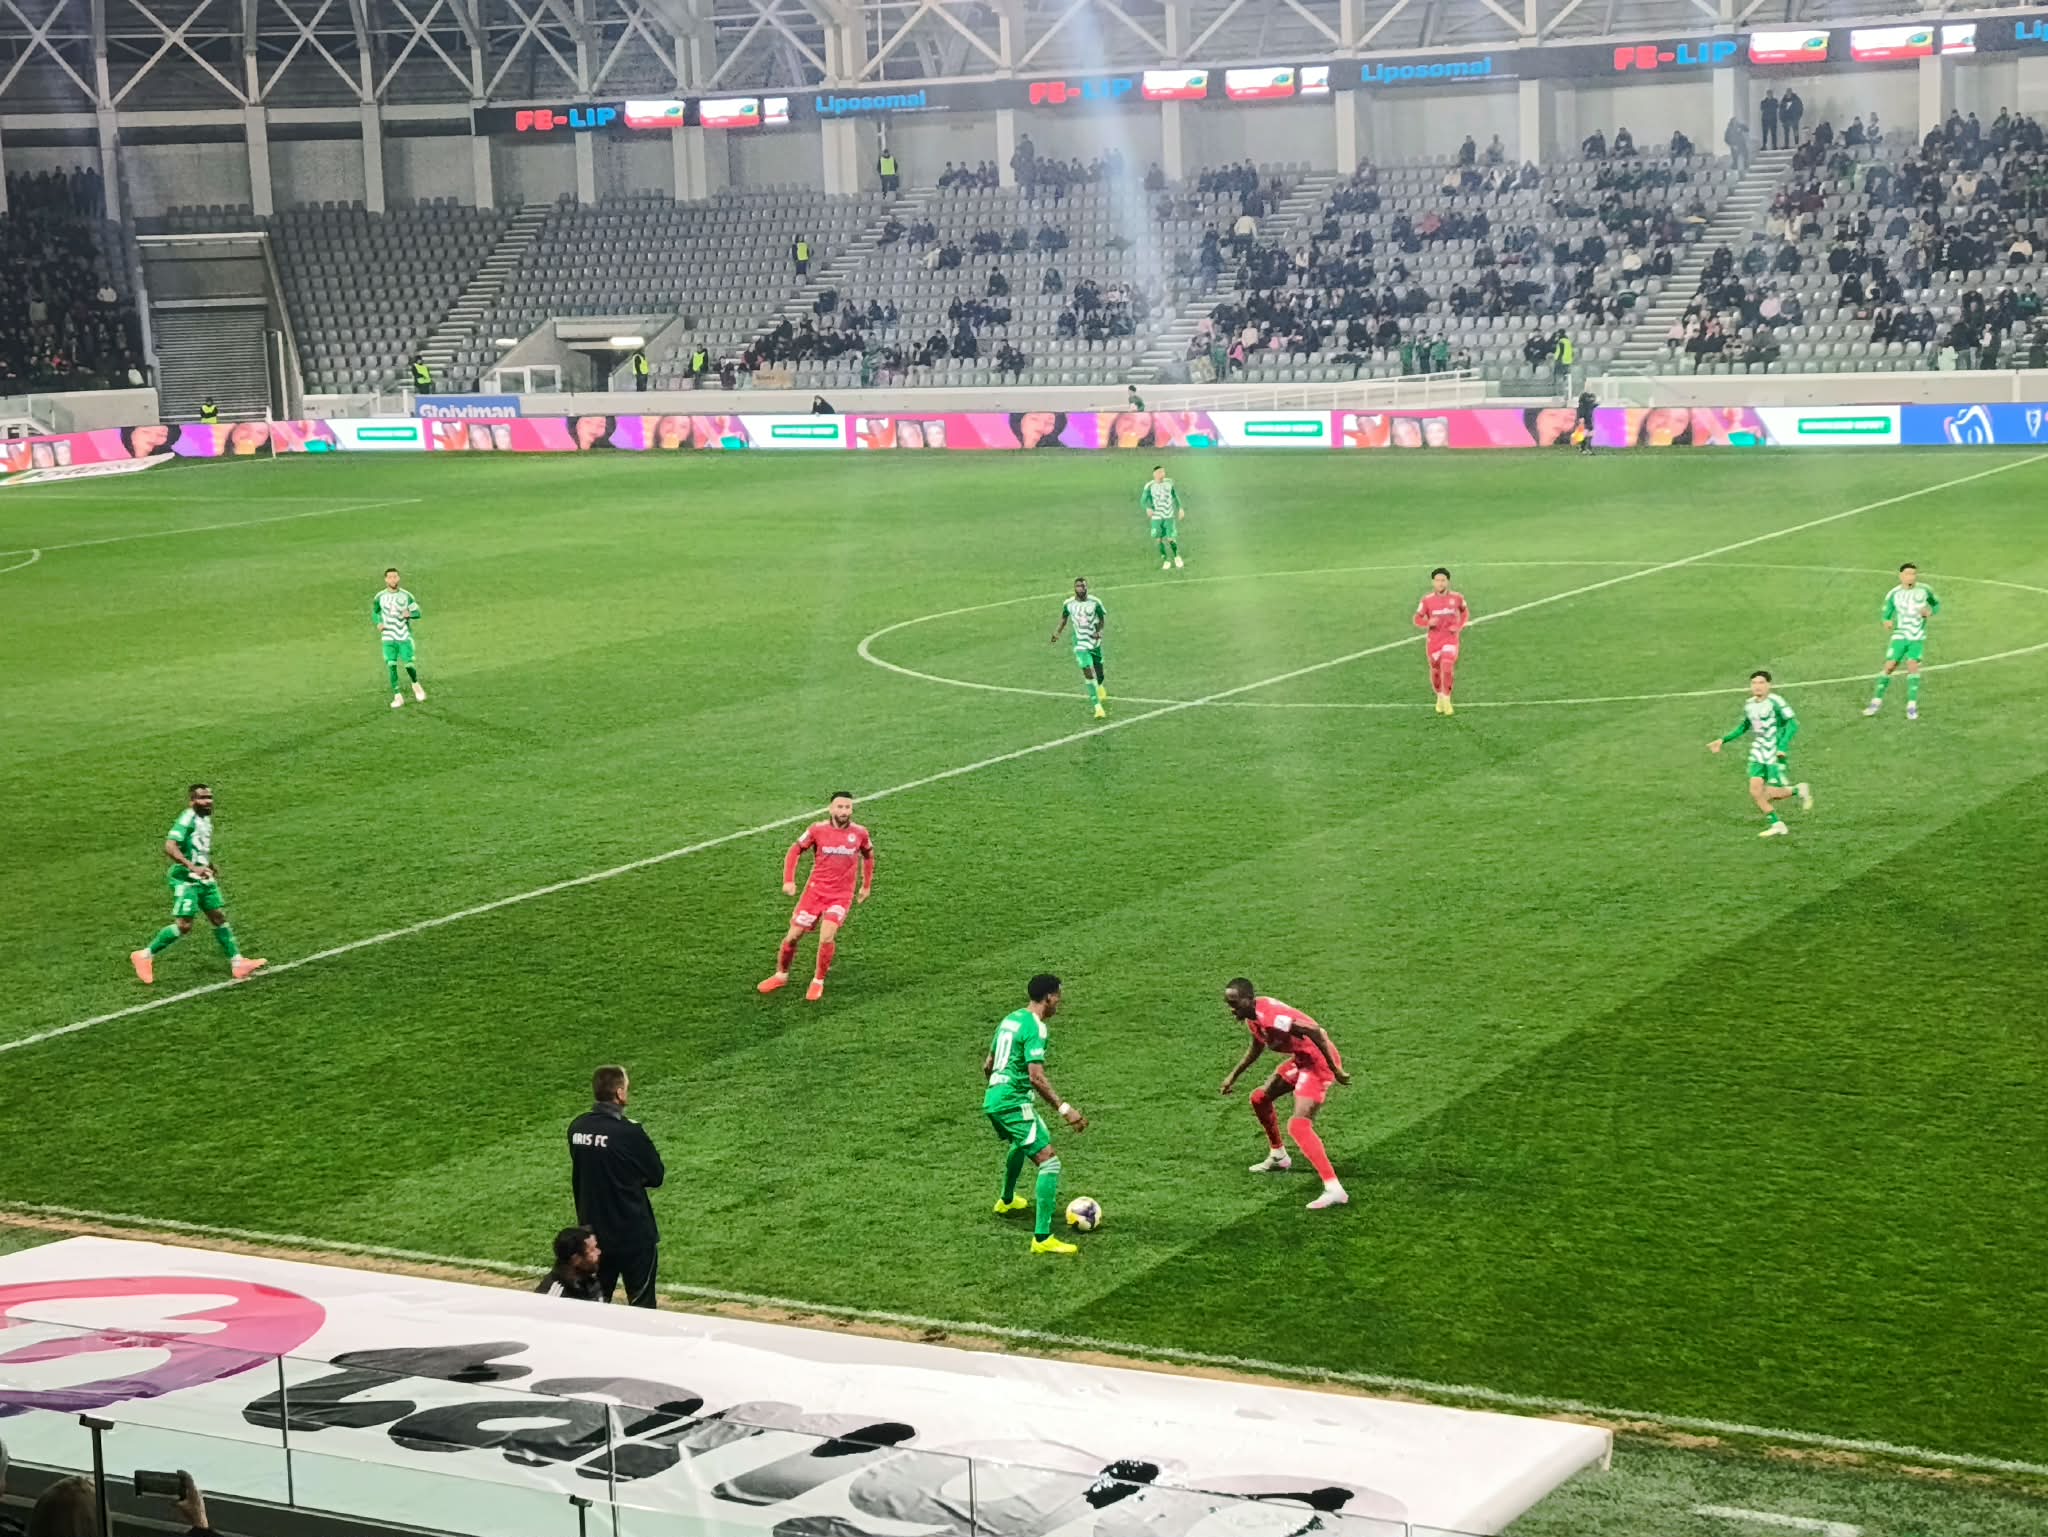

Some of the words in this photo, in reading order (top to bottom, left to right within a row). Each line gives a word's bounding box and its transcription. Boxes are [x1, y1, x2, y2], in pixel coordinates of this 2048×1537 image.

[1614, 41, 1737, 70] FE-LIP
[1361, 56, 1492, 84] Liposomal
[816, 89, 927, 114] Liposomal
[1029, 78, 1132, 104] FE-LIP
[516, 107, 616, 132] FE-LIP
[572, 1132, 593, 1146] ARIS
[594, 1134, 609, 1148] FC
